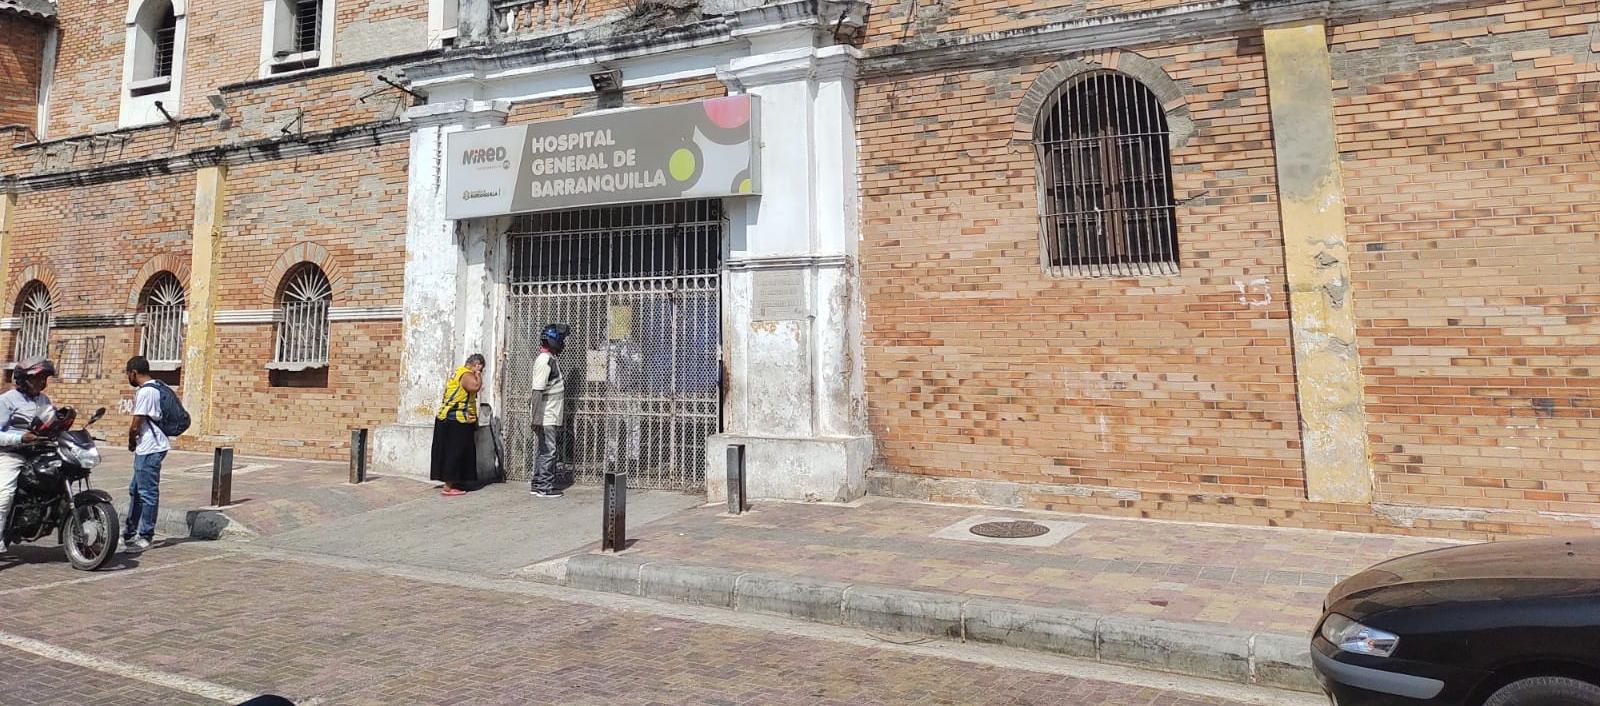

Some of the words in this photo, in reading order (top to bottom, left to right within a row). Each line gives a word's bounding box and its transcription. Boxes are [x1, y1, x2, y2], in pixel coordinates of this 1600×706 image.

[532, 129, 616, 154] HOSPITAL
[531, 152, 608, 176] GENERAL
[613, 148, 636, 168] DE
[531, 168, 667, 198] BARRANQUILLA
